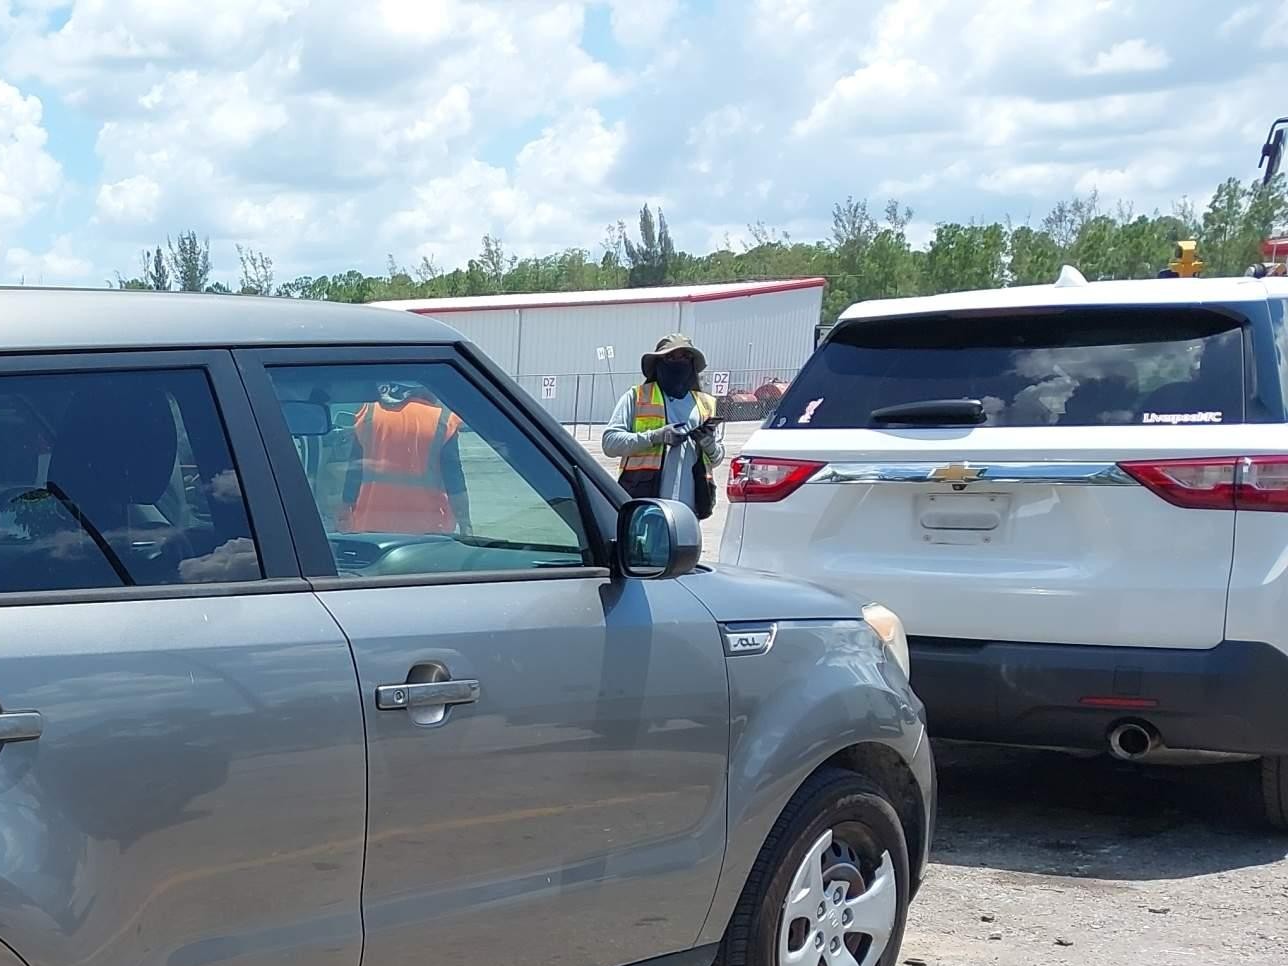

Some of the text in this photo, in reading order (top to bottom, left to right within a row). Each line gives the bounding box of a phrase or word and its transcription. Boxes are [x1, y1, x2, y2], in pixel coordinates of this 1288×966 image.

[543, 377, 555, 387] DZ
[714, 373, 728, 384] DZ
[545, 388, 552, 397] 11
[715, 385, 724, 394] 12
